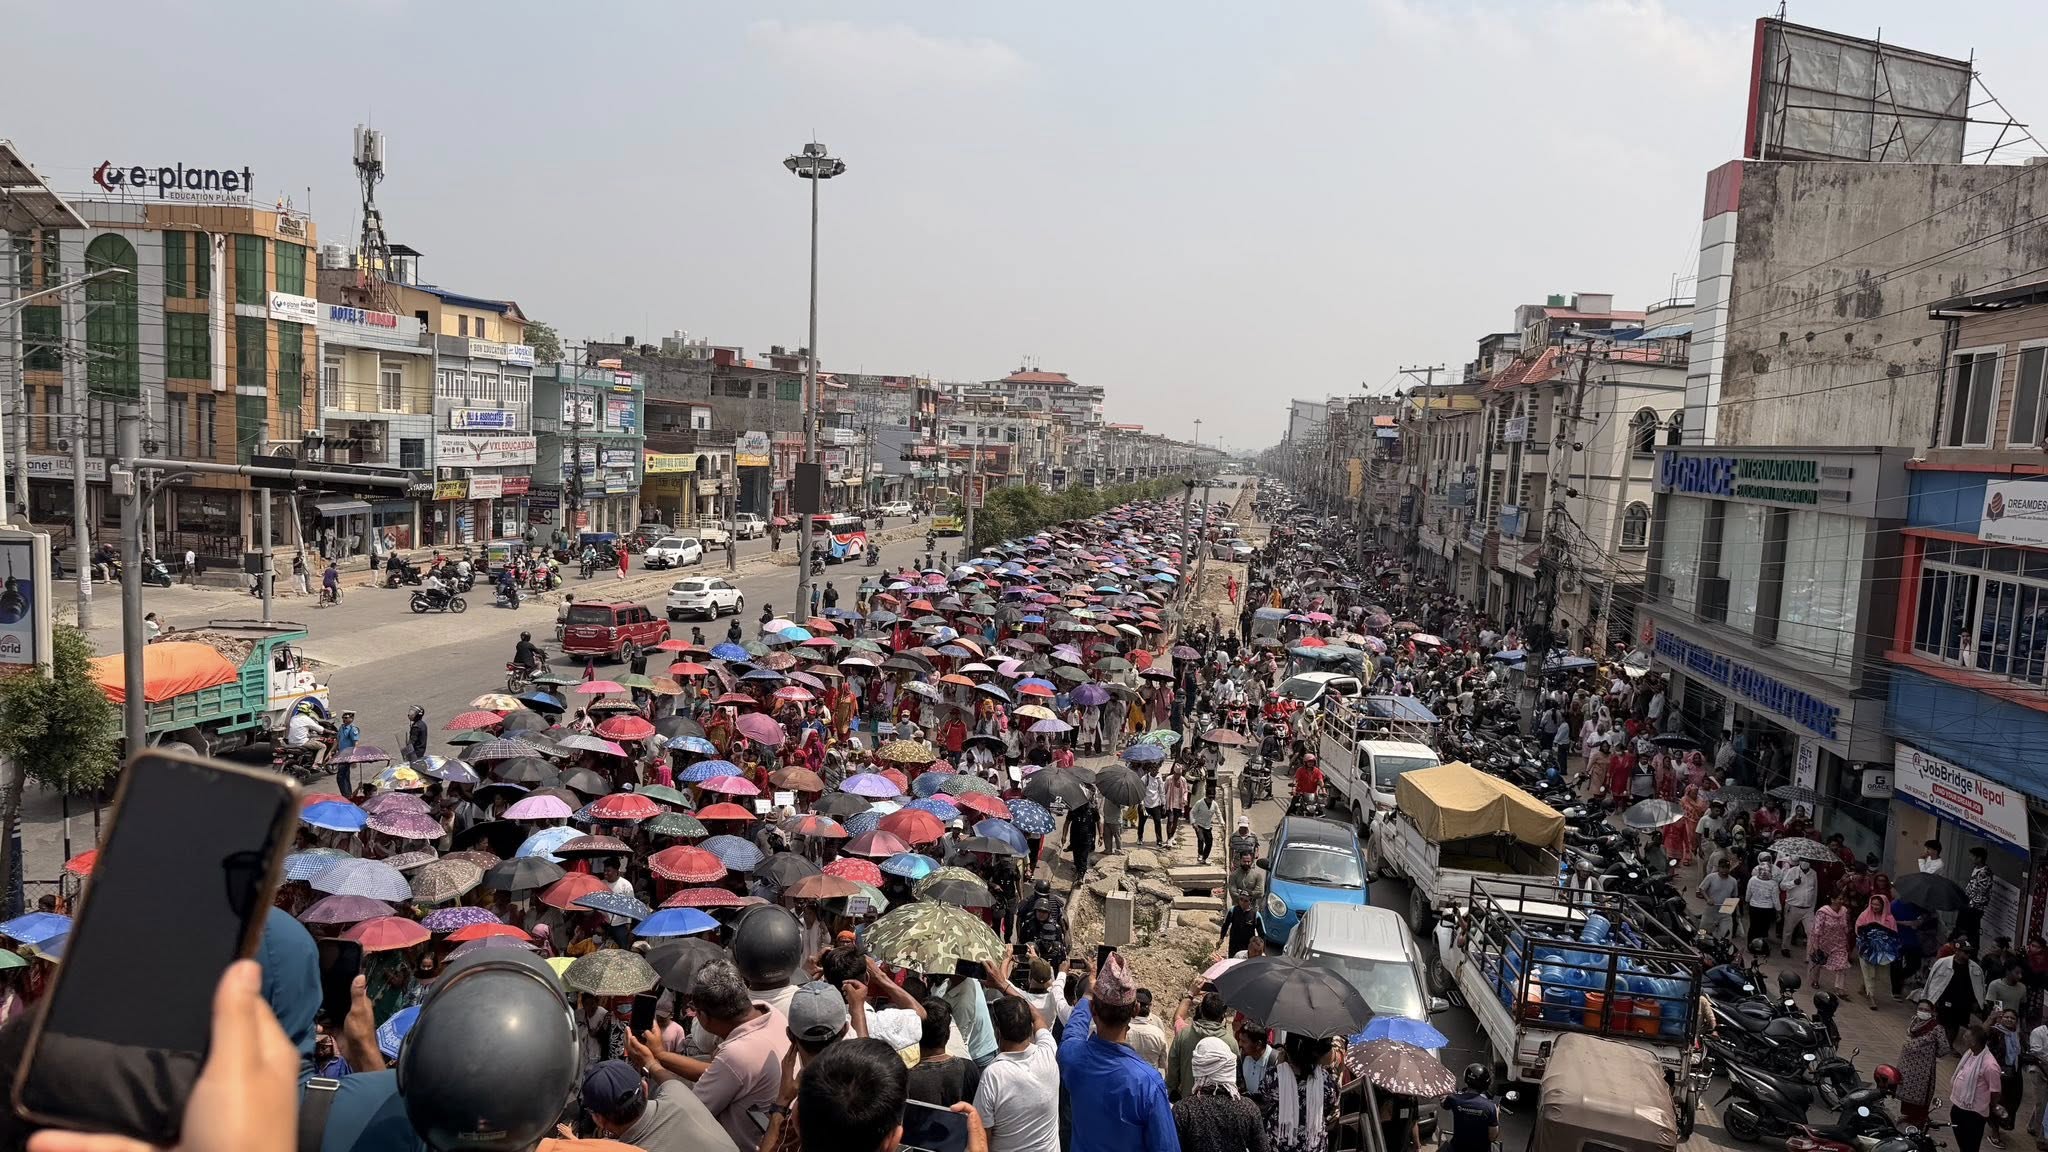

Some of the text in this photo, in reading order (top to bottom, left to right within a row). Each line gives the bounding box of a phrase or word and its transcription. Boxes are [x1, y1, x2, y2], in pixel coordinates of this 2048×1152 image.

[130, 162, 250, 199] e-planet
[170, 191, 246, 203] EDUCATION PLANET
[330, 305, 356, 323] HOTEL
[502, 440, 535, 450] EDUCATION
[85, 461, 103, 471] PTE
[1675, 457, 1738, 497] GRACE
[2008, 498, 2048, 510] DREAMDES
[0, 643, 21, 654] orld
[1731, 662, 1841, 740] FURNITURE
[1923, 758, 1973, 796] JobBridge
[1974, 780, 2005, 808] Nepal
